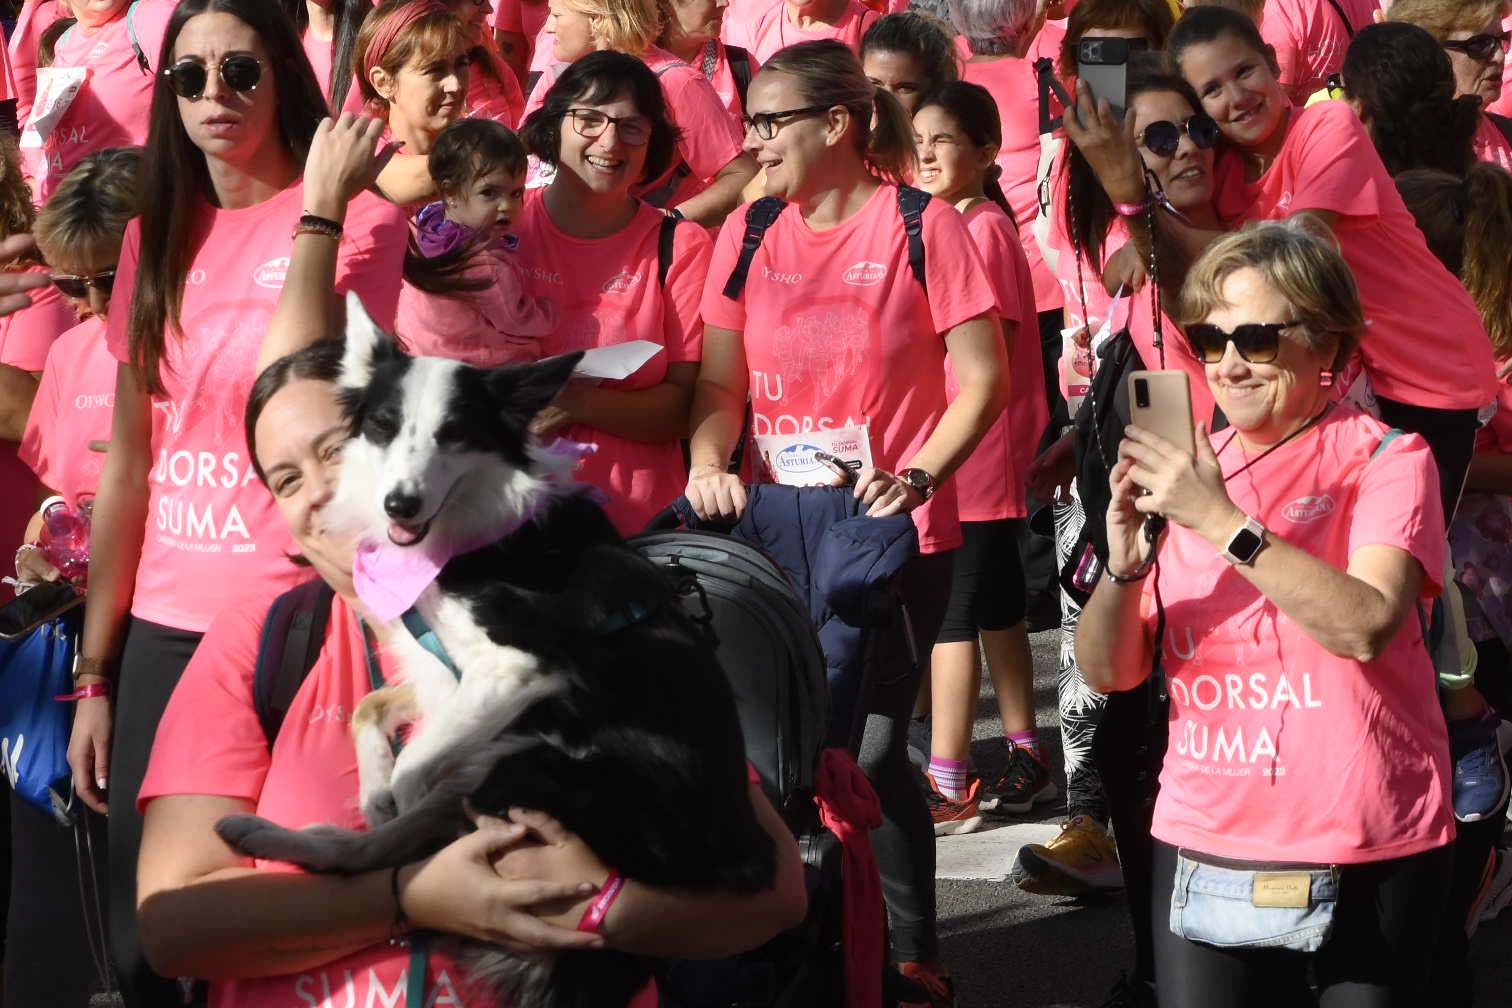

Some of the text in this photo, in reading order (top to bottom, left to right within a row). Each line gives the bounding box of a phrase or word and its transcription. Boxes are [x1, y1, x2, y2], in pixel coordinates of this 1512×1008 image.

[753, 372, 783, 401] TU
[156, 448, 258, 489] DORSA
[832, 444, 859, 454] SUMA
[156, 496, 251, 540] SUMA
[1171, 672, 1323, 711] DORSAL
[1177, 719, 1281, 764] SUMA
[295, 967, 464, 1008] SUMA
